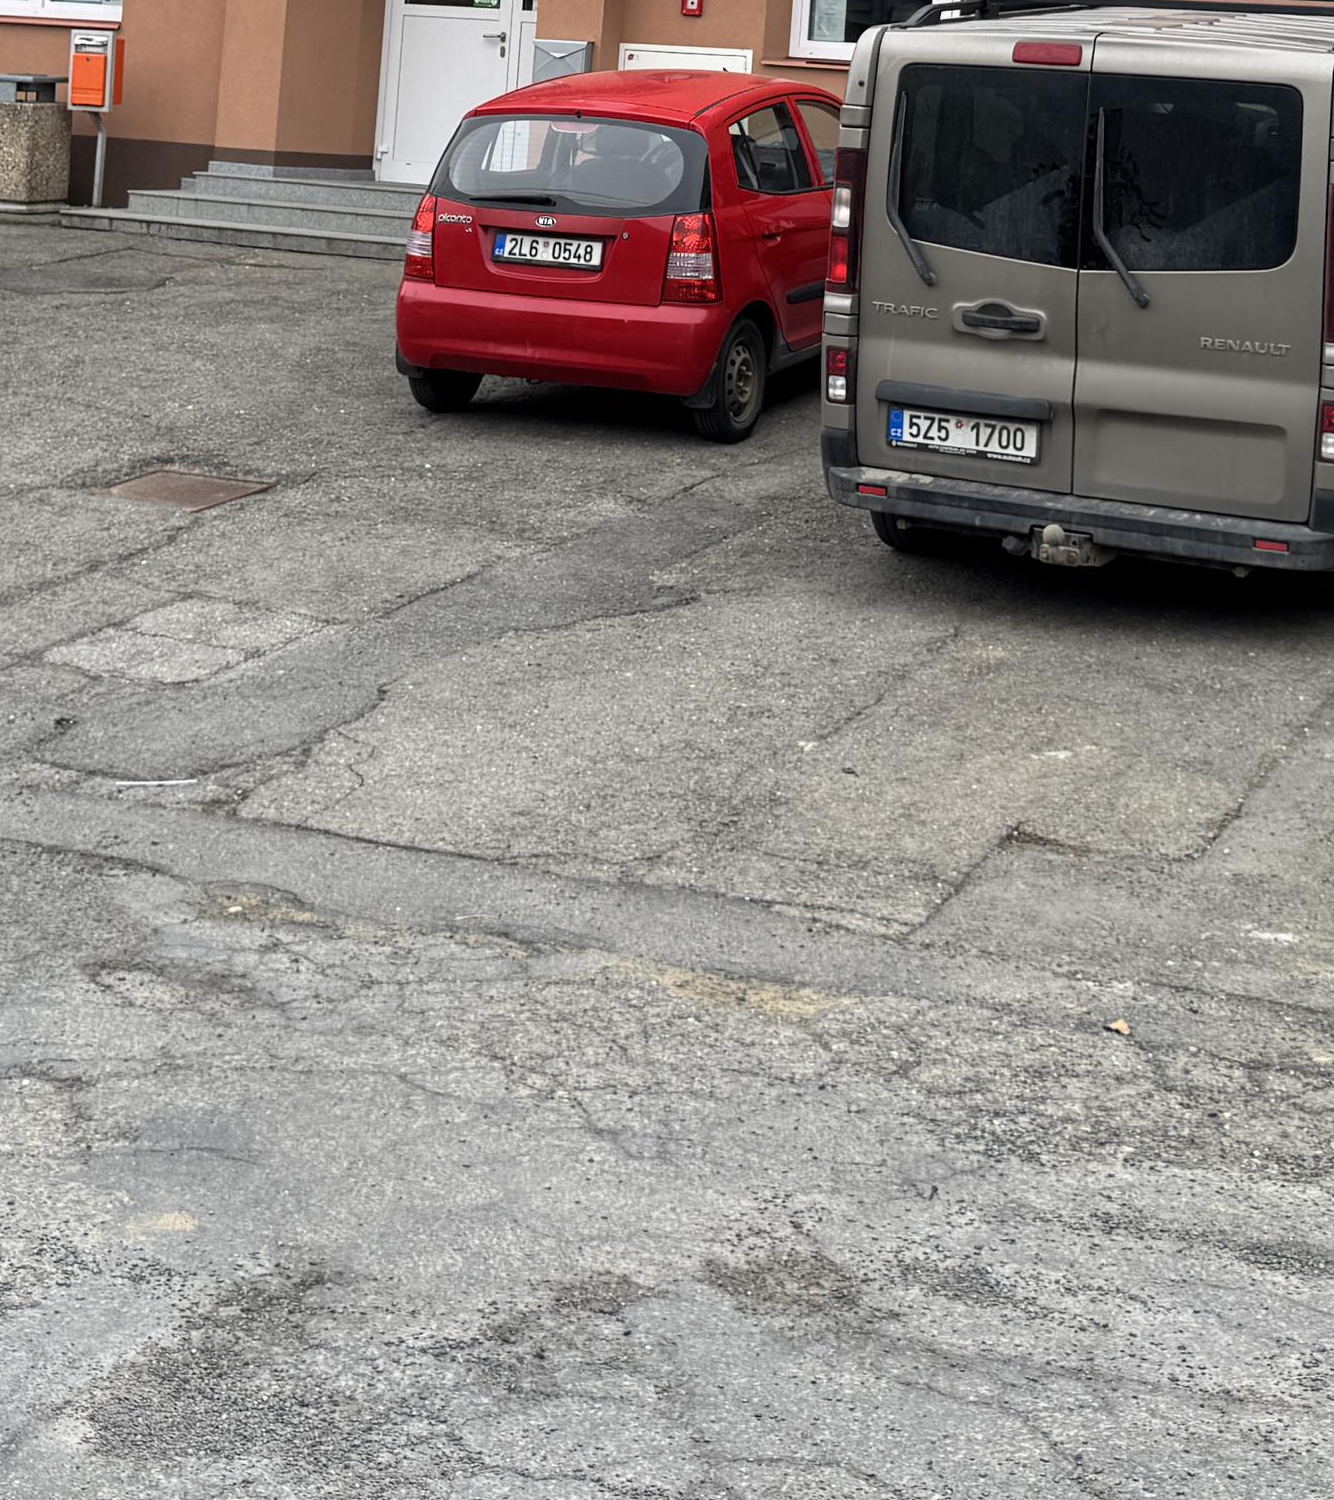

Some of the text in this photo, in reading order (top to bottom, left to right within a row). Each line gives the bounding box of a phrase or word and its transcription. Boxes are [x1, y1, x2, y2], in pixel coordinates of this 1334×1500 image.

[507, 237, 539, 258] 2L6
[552, 241, 594, 263] 0548
[871, 301, 940, 319] TRAFIC
[1200, 336, 1291, 356] RENAULT
[890, 414, 1025, 451] CZ 5Z5 1700
